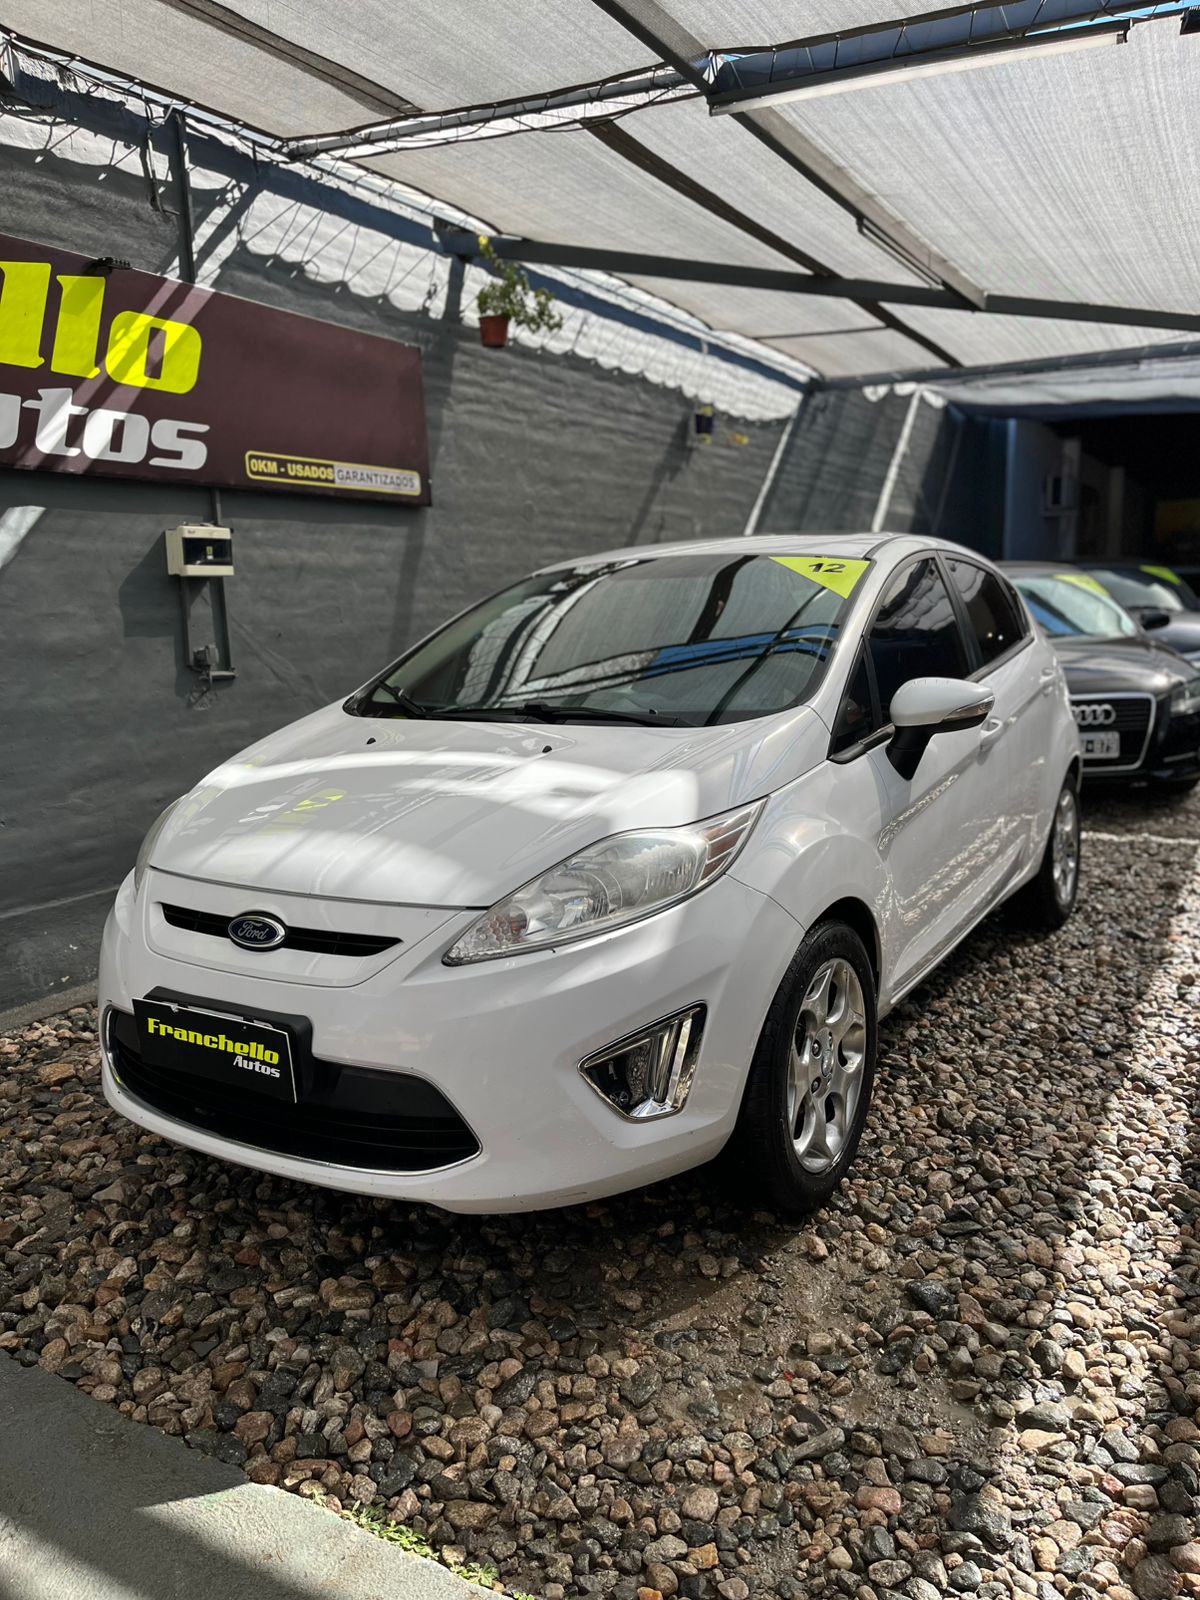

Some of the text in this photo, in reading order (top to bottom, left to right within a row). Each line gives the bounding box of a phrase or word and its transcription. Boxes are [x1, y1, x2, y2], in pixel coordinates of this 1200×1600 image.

[287, 463, 334, 480] USADOS
[336, 469, 415, 488] GARANTIZADOS
[808, 563, 846, 573] 12
[237, 920, 269, 940] Ford
[147, 1017, 279, 1065] Franchello
[233, 1055, 280, 1078] Autos
